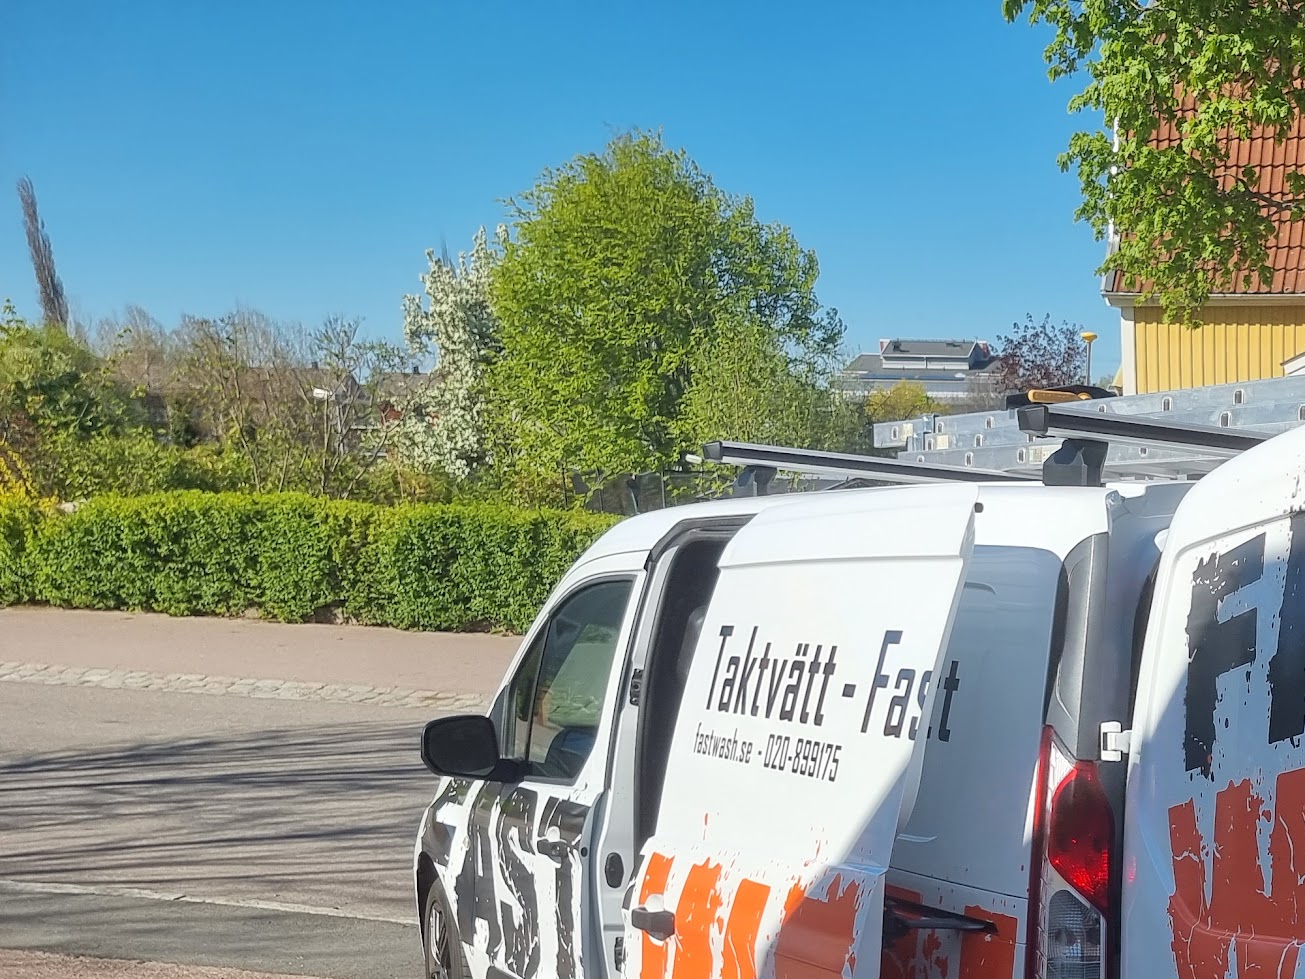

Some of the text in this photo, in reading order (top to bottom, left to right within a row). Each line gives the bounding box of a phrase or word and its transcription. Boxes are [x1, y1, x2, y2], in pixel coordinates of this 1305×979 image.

[706, 625, 838, 727] Taktvätt
[693, 722, 753, 765] fastwash.se
[763, 733, 842, 782] 020-899175
